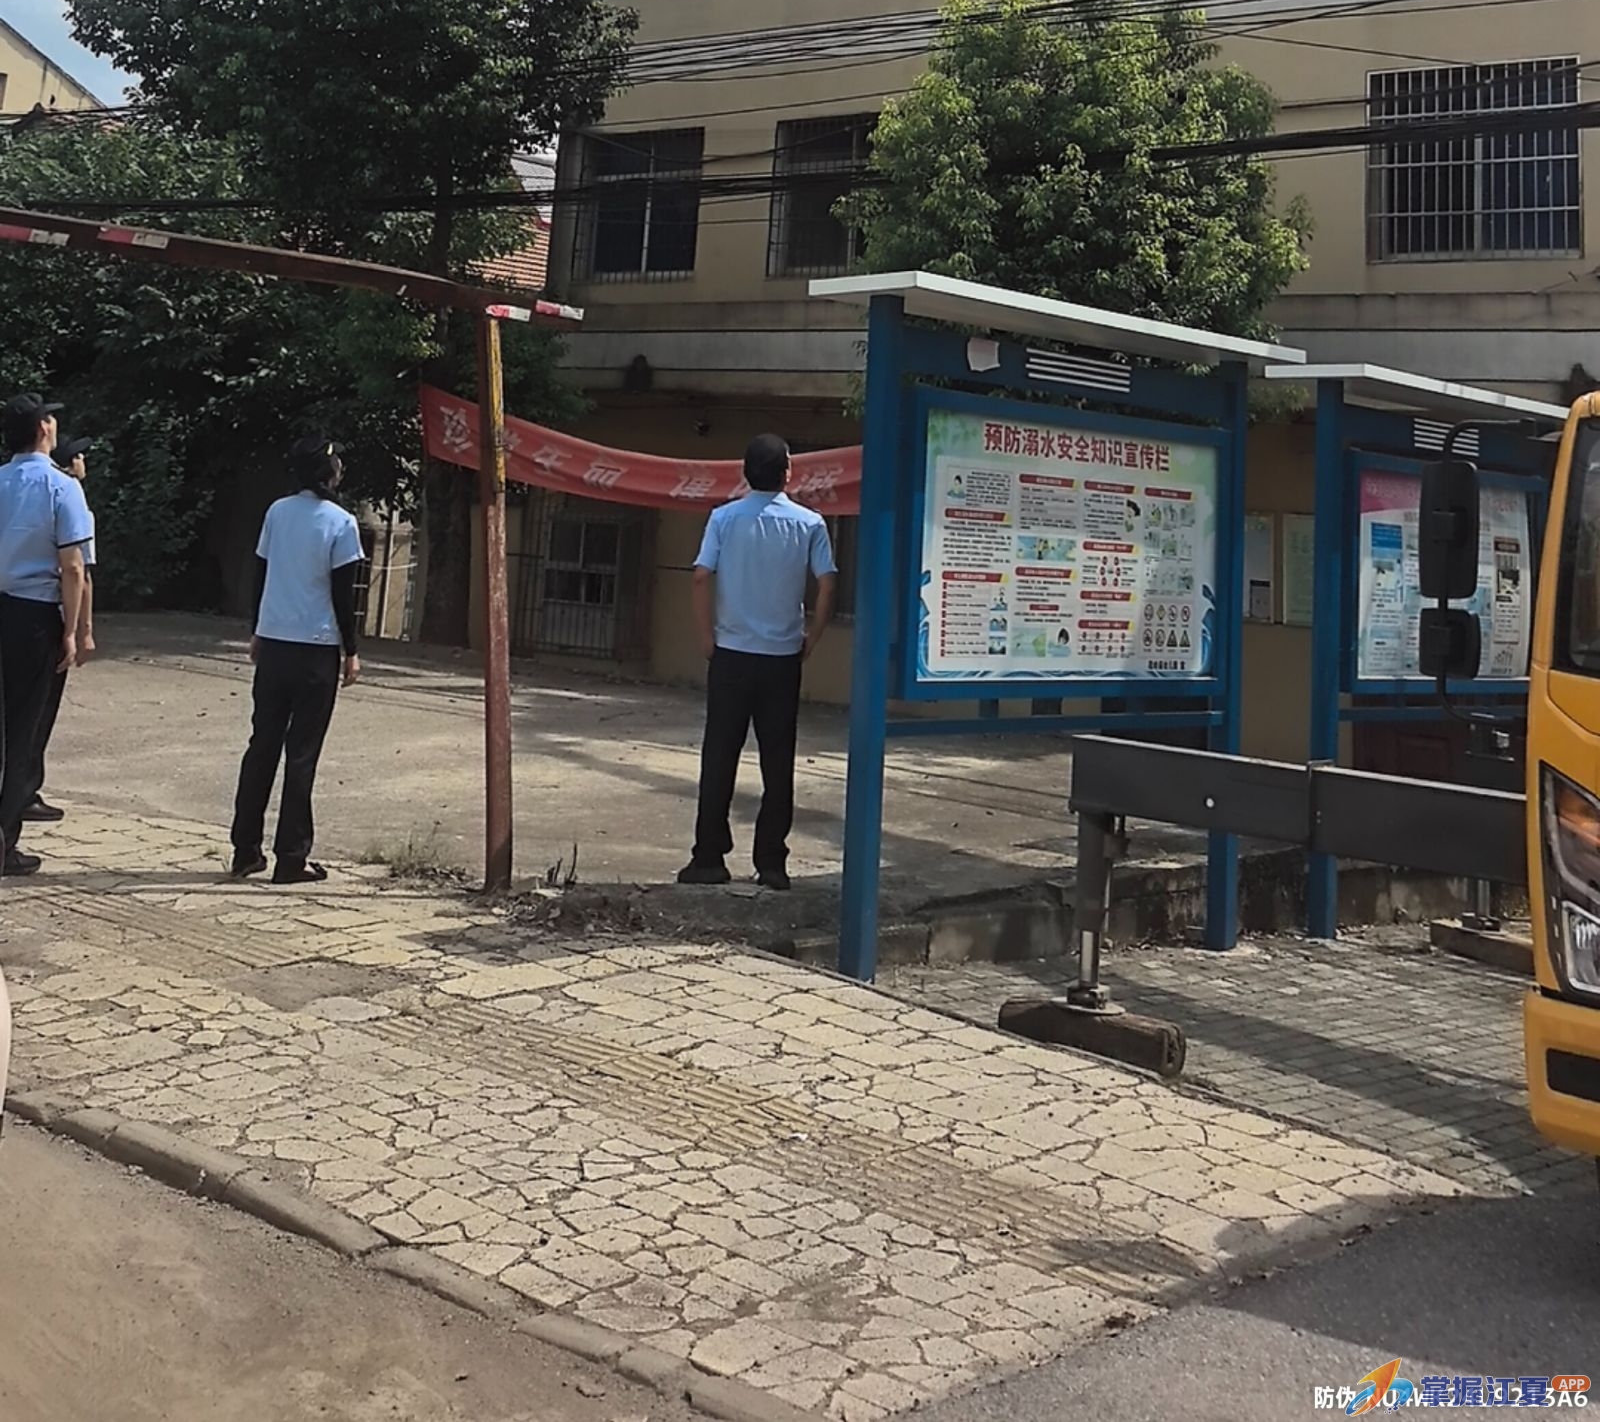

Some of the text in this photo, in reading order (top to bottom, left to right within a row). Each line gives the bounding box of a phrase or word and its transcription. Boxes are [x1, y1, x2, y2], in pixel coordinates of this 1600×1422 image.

[983, 421, 1171, 472] 预防溺水安全知识宣传栏
